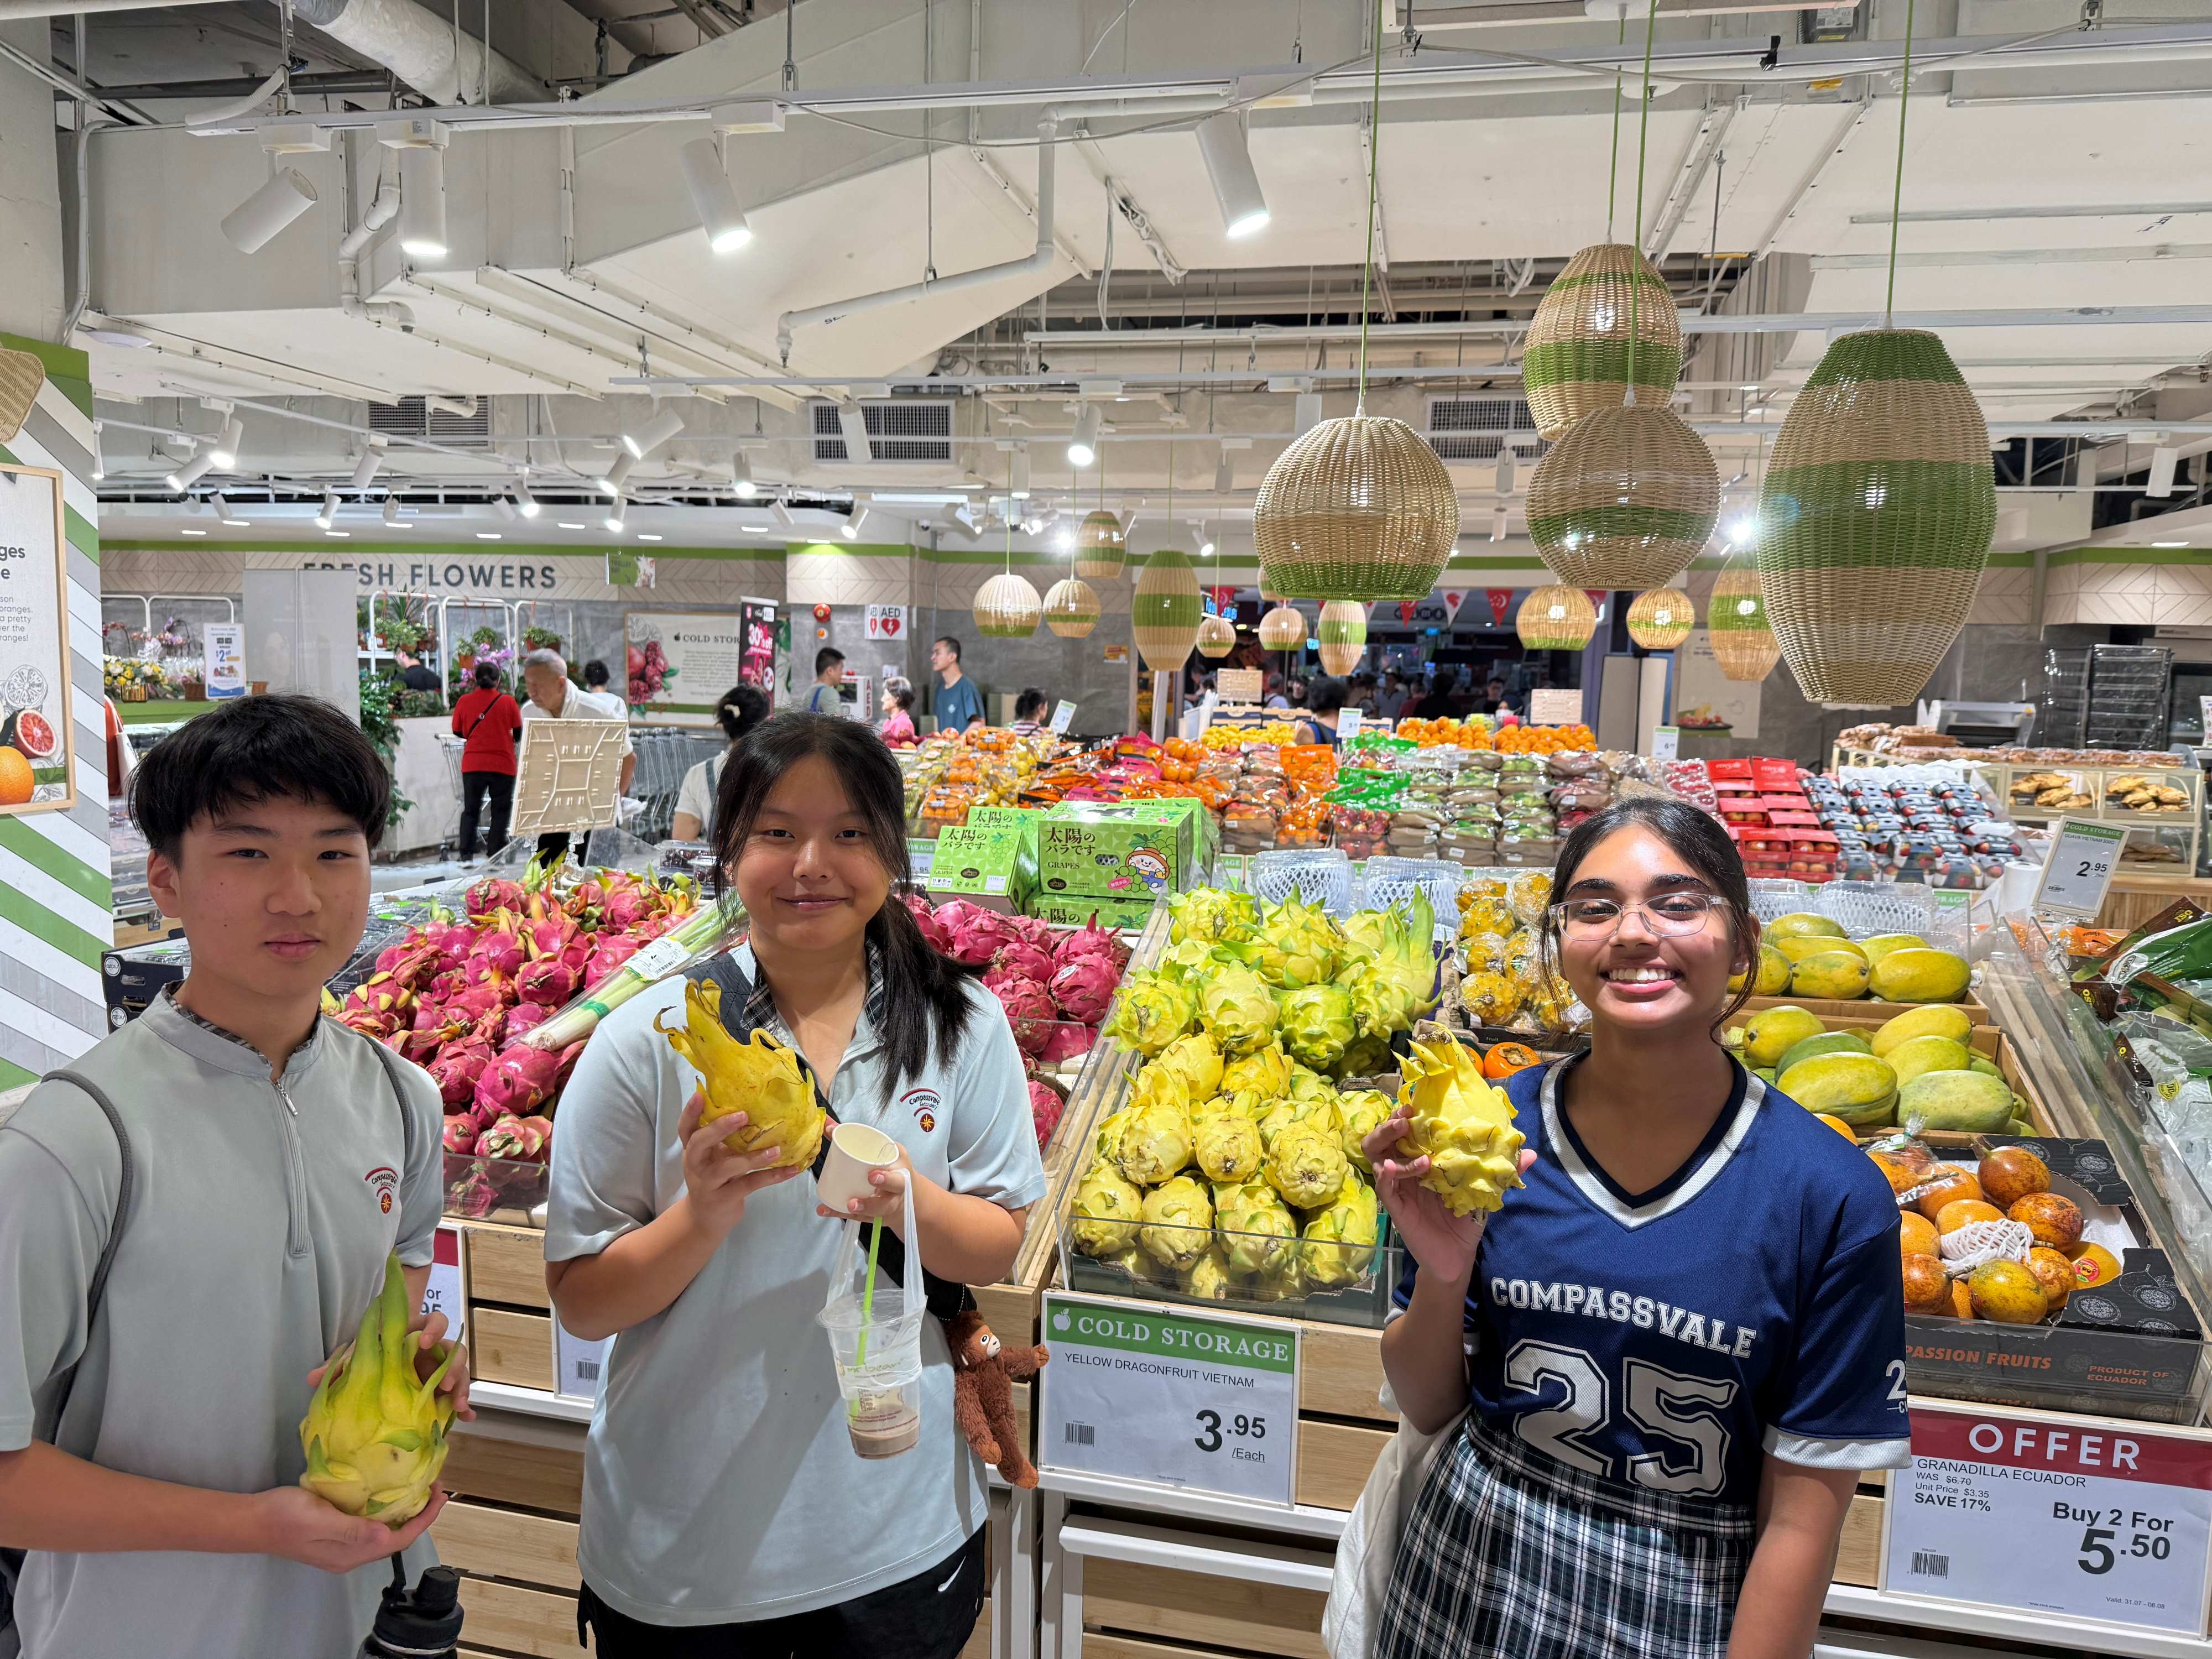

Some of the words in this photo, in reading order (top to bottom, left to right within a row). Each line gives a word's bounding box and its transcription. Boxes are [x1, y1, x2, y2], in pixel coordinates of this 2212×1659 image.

[411, 564, 556, 588] FLOWERS
[870, 607, 878, 617] AED
[881, 607, 901, 618] AED
[683, 634, 710, 643] COLD
[713, 635, 740, 644] STOR
[974, 810, 1012, 823] 太陽の
[945, 828, 987, 842] 太陽の
[1046, 827, 1095, 844] 太陽の
[2089, 827, 2120, 837] STORAGE
[942, 842, 985, 851] バラです
[1046, 844, 1095, 856] バラです
[2075, 860, 2108, 877] 2.95
[909, 1095, 940, 1105] Compassvale
[1490, 1276, 1757, 1359] COMPASSVALE
[1078, 1316, 1150, 1342] COLD
[1161, 1327, 1288, 1361] STORAGE
[1986, 1353, 2053, 1370] FRUITS
[1065, 1353, 1112, 1368] YELLOW
[1115, 1359, 1199, 1380] DRAGONFRUIT
[1202, 1371, 1254, 1388] VIETNAM
[2089, 1365, 2148, 1376] PRODUCT
[2087, 1374, 2147, 1385] ECUADOR
[1504, 1338, 1739, 1498] 25
[1194, 1409, 1266, 1452] 3.95
[1231, 1447, 1265, 1463] /Each
[1969, 1423, 2140, 1470] OFFER
[1916, 1472, 1939, 1481] WAS
[1945, 1475, 1971, 1486] $6.70
[1917, 1458, 2008, 1479] GRANADILLA
[2012, 1470, 2086, 1488] ECUADOR
[1915, 1482, 1933, 1491] Unit
[1936, 1484, 1959, 1494] Price
[1964, 1488, 1989, 1499] $3.35
[1914, 1492, 1957, 1508] SAVE
[1960, 1498, 1991, 1512] 17%
[2053, 1501, 2101, 1527] Buy
[2109, 1509, 2122, 1526] 2
[2131, 1511, 2174, 1532] For
[2078, 1527, 2171, 1575] 5.50
[2106, 1596, 2124, 1604] Valid:
